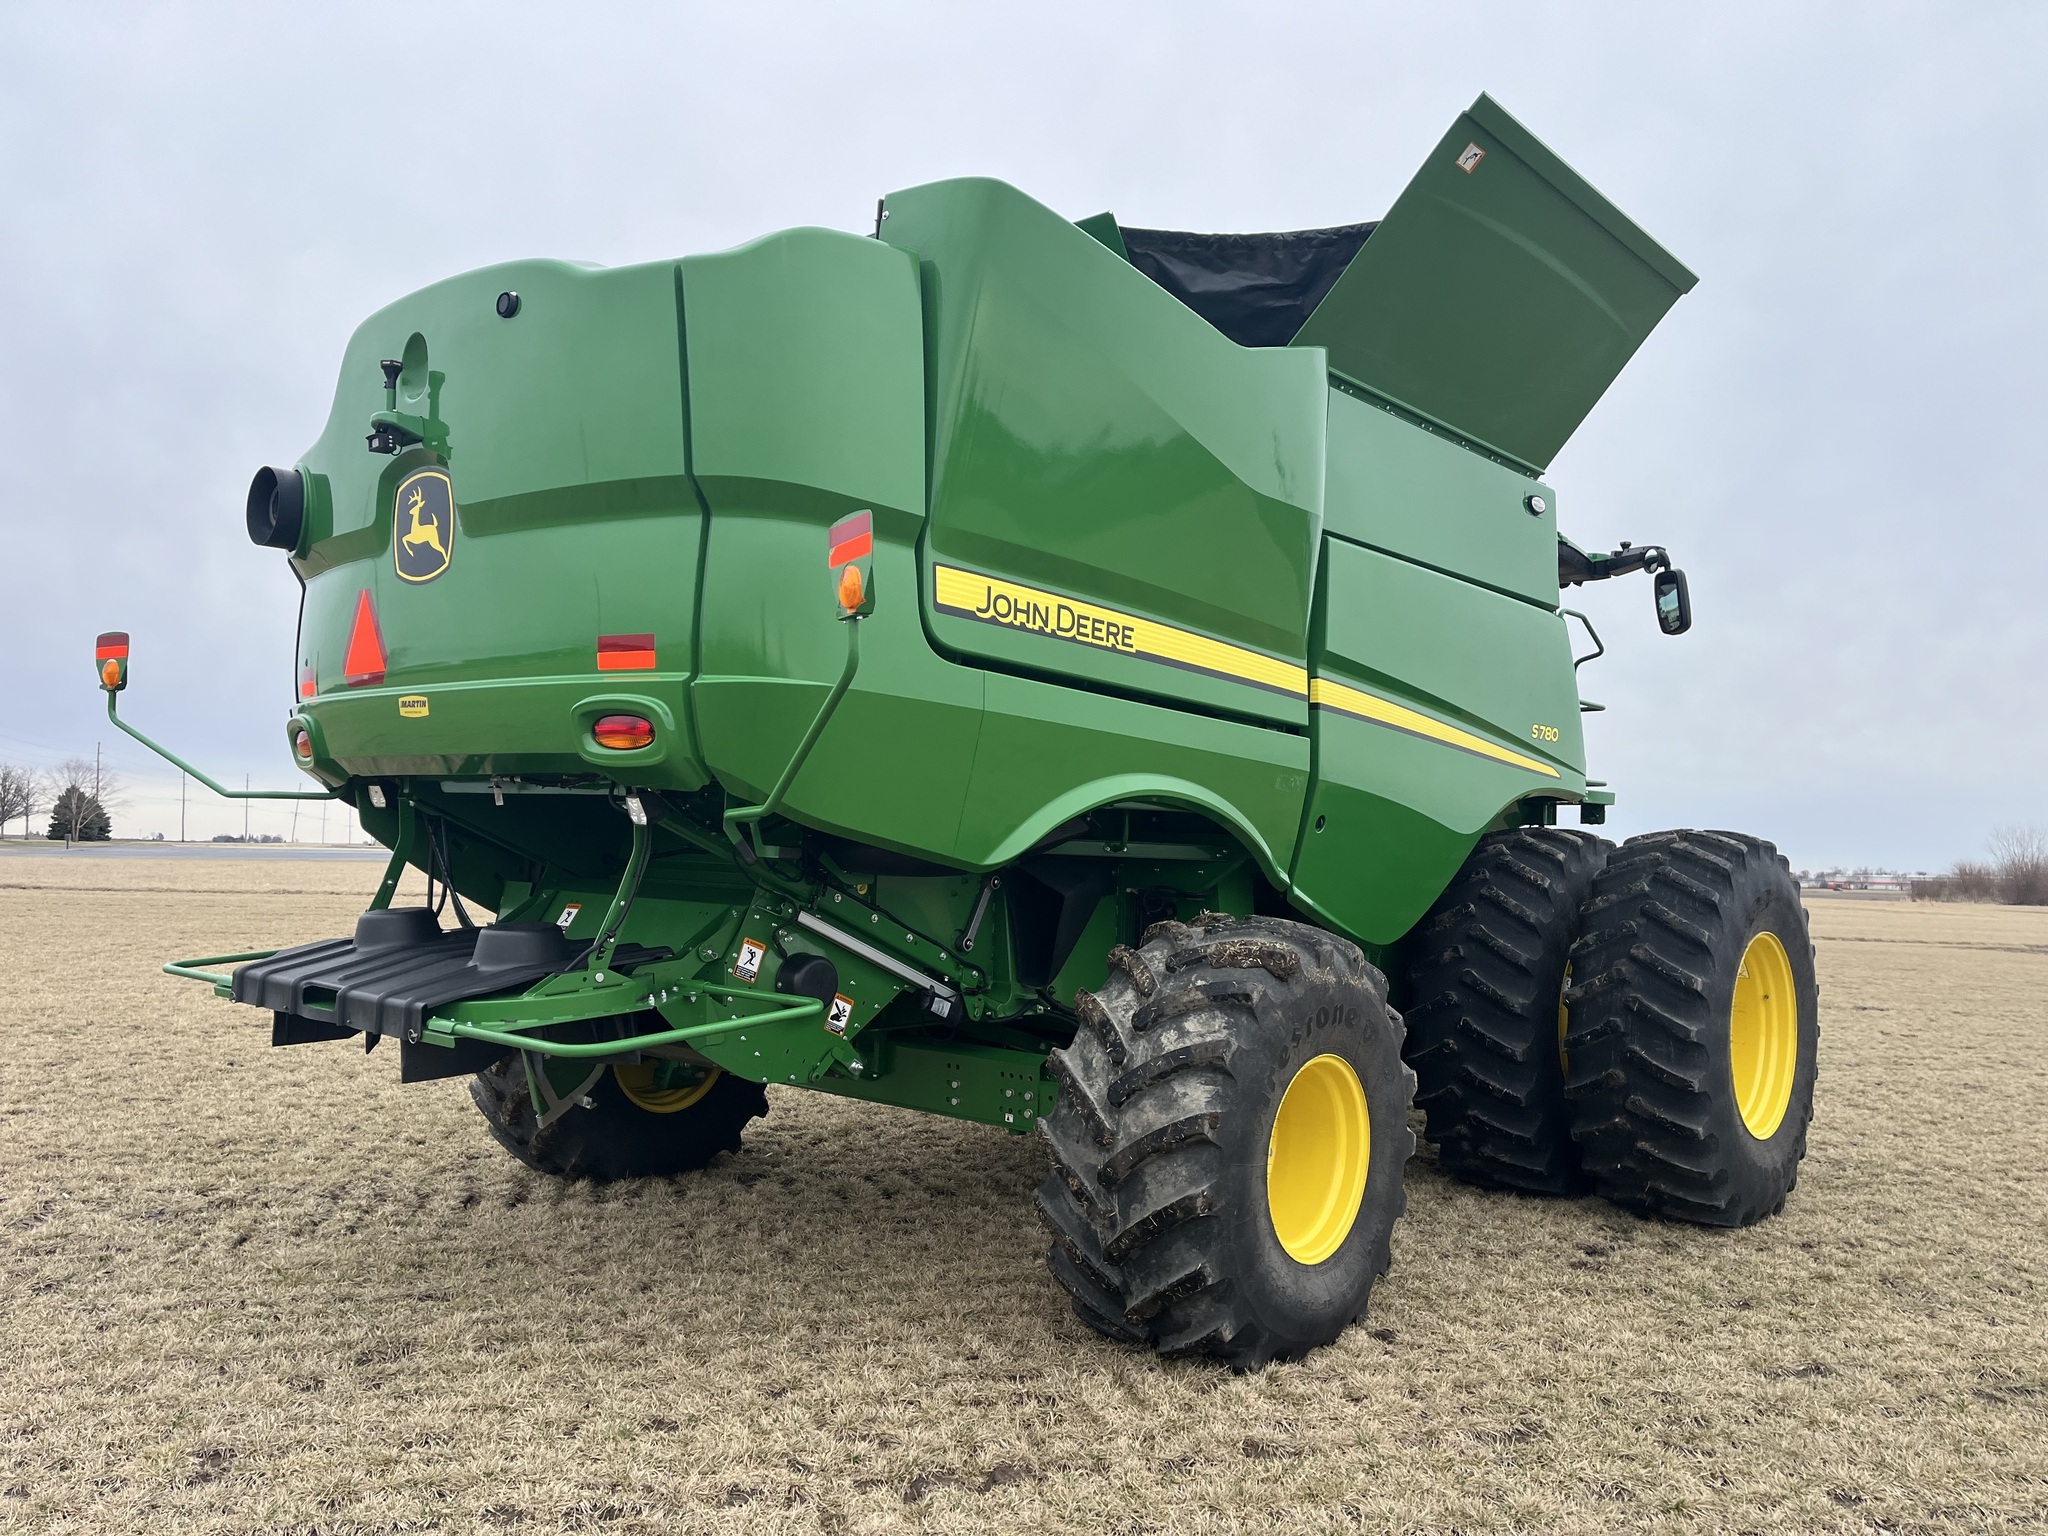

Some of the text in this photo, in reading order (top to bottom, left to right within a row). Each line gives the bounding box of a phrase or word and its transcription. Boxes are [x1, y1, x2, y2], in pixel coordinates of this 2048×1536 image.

[975, 585, 1135, 650] JOHN DEERE
[401, 700, 426, 708] MARTIN
[1531, 723, 1560, 743] S780
